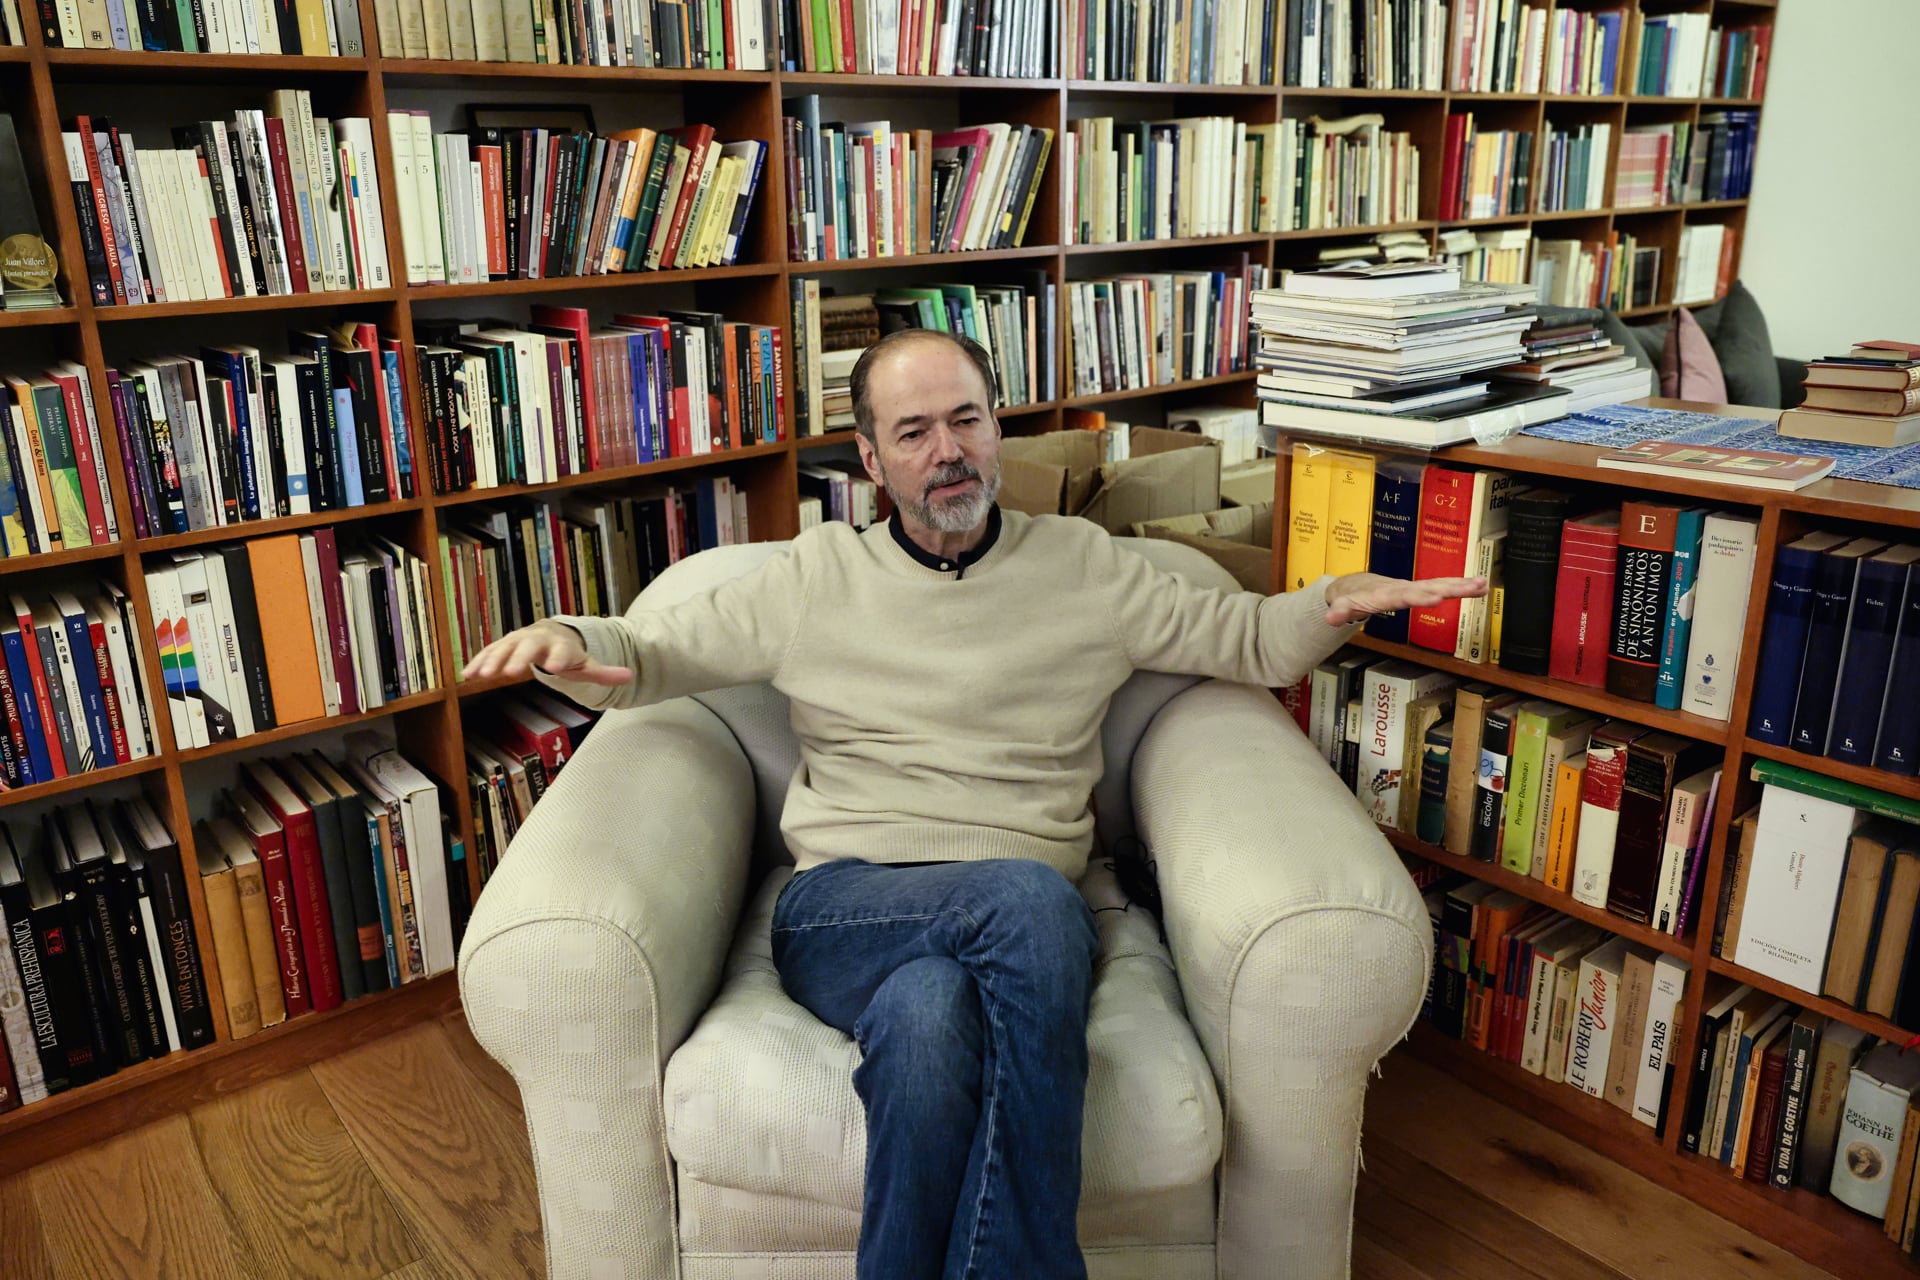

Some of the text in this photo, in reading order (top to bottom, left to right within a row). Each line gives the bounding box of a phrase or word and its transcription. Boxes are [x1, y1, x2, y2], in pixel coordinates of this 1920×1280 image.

[301, 97, 311, 120] espejo
[304, 120, 311, 128] el
[306, 129, 312, 138] en
[305, 138, 317, 165] Salvaje
[358, 150, 372, 192] Mutaciones
[95, 187, 110, 224] REGRESO
[123, 190, 136, 219] fractura
[104, 231, 114, 241] LA
[129, 219, 143, 254] mexicana
[22, 257, 45, 266] Villoro
[106, 242, 120, 267] JAULA
[320, 345, 327, 354] EL
[321, 355, 330, 381] DIABLO
[771, 345, 786, 397] ZAPATISTAS
[326, 396, 336, 429] CORAZÓN
[446, 387, 460, 454] PÓLVORA EN LA BOCA
[29, 428, 40, 447] Credit
[36, 457, 47, 476] Blame
[240, 425, 250, 454] imaginada
[96, 466, 105, 480] Weil
[99, 481, 110, 505] Simone
[248, 491, 255, 499] La
[1382, 491, 1401, 504] A-F
[1435, 493, 1457, 509] G-Z
[1639, 514, 1657, 535] E
[1616, 551, 1635, 653] DICCIONARIO ESPASA
[1626, 550, 1648, 657] DE SINÓNIMOS
[1671, 582, 1681, 606] mundo
[1419, 613, 1445, 624] AGUILAR
[1669, 616, 1677, 627] en
[1639, 649, 1652, 659] Y
[1664, 657, 1671, 665] El
[104, 687, 125, 756] THE NEW WORLD BORDER
[1370, 683, 1391, 757] Larousse
[0, 734, 13, 761] SLAVOJ
[1544, 753, 1556, 792] GRAMMATIK
[1482, 792, 1494, 827] escolar
[1512, 799, 1525, 825] Primer
[136, 957, 148, 986] ANTIGUO
[168, 919, 194, 1012] VIVIR ENTONCES
[11, 917, 58, 1049] LA ESCULTURA PREHISPÁNICA
[1580, 969, 1608, 1031] Junior
[147, 1010, 156, 1023] DEL
[1571, 1010, 1595, 1090] LE ROBERT
[1648, 1020, 1668, 1072] EL PAÍS
[1789, 1048, 1807, 1092] Herman Grimm
[1845, 1114, 1895, 1142] GOETHE
[1846, 1107, 1881, 1128] JOHANN
[1776, 1094, 1801, 1169] VIDA DE GOETHE
